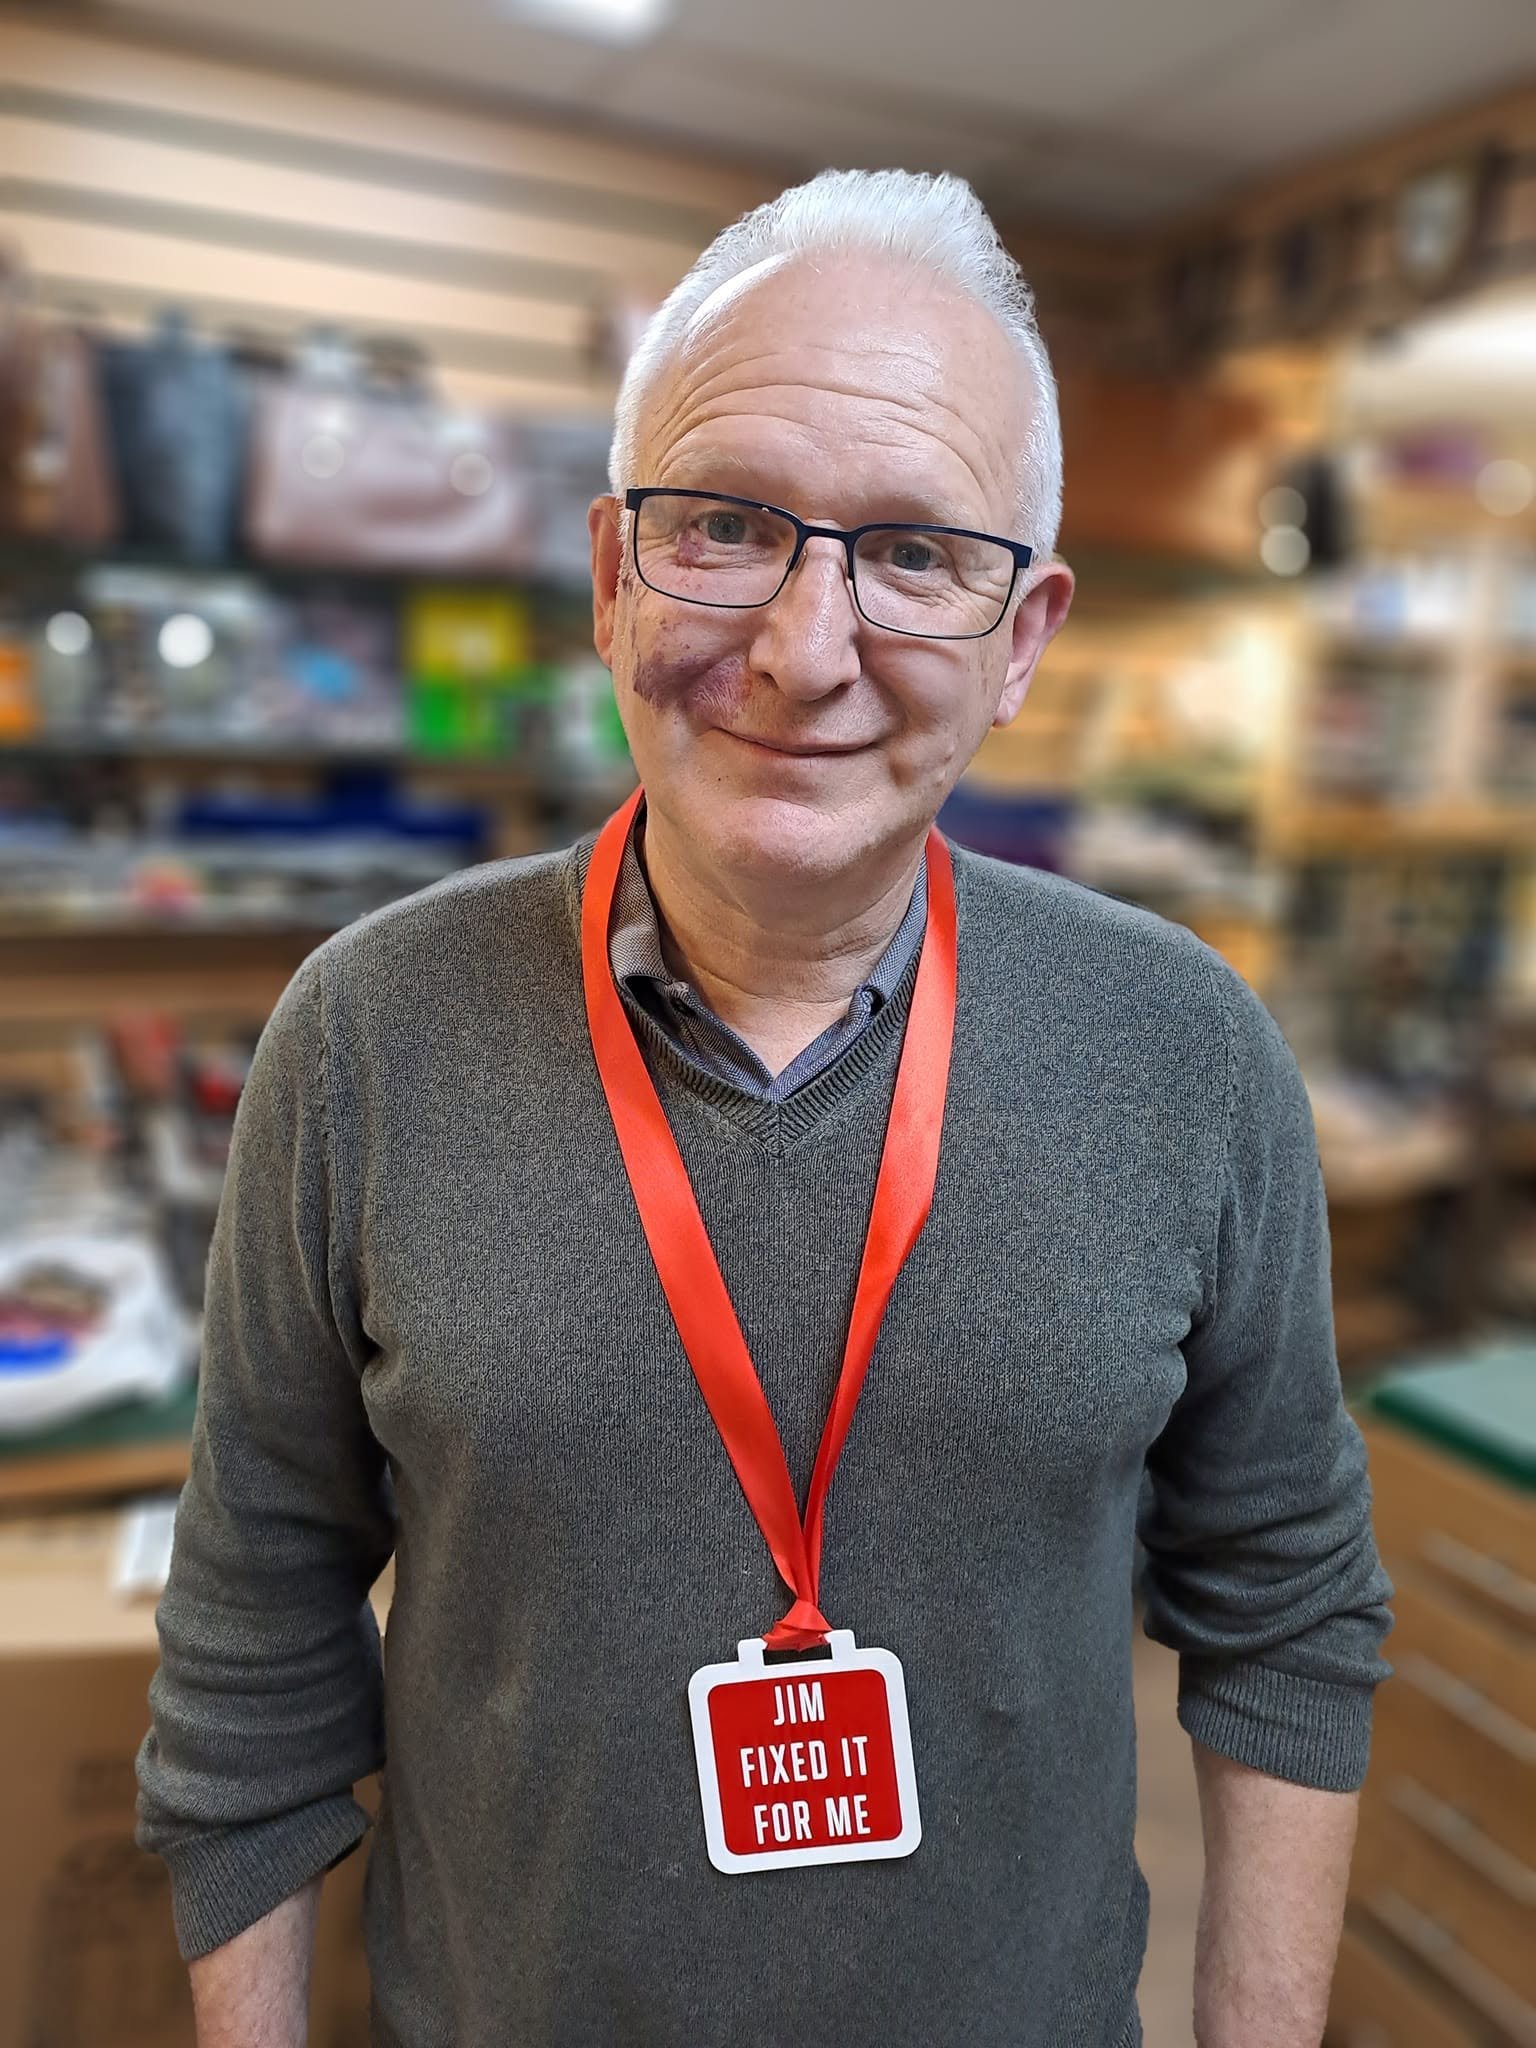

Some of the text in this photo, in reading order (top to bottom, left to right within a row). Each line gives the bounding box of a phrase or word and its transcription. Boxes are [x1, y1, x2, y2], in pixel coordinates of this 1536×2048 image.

[773, 1681, 825, 1726] JIM
[740, 1735, 868, 1788] FIXED IT
[753, 1794, 871, 1845] FOR ME
